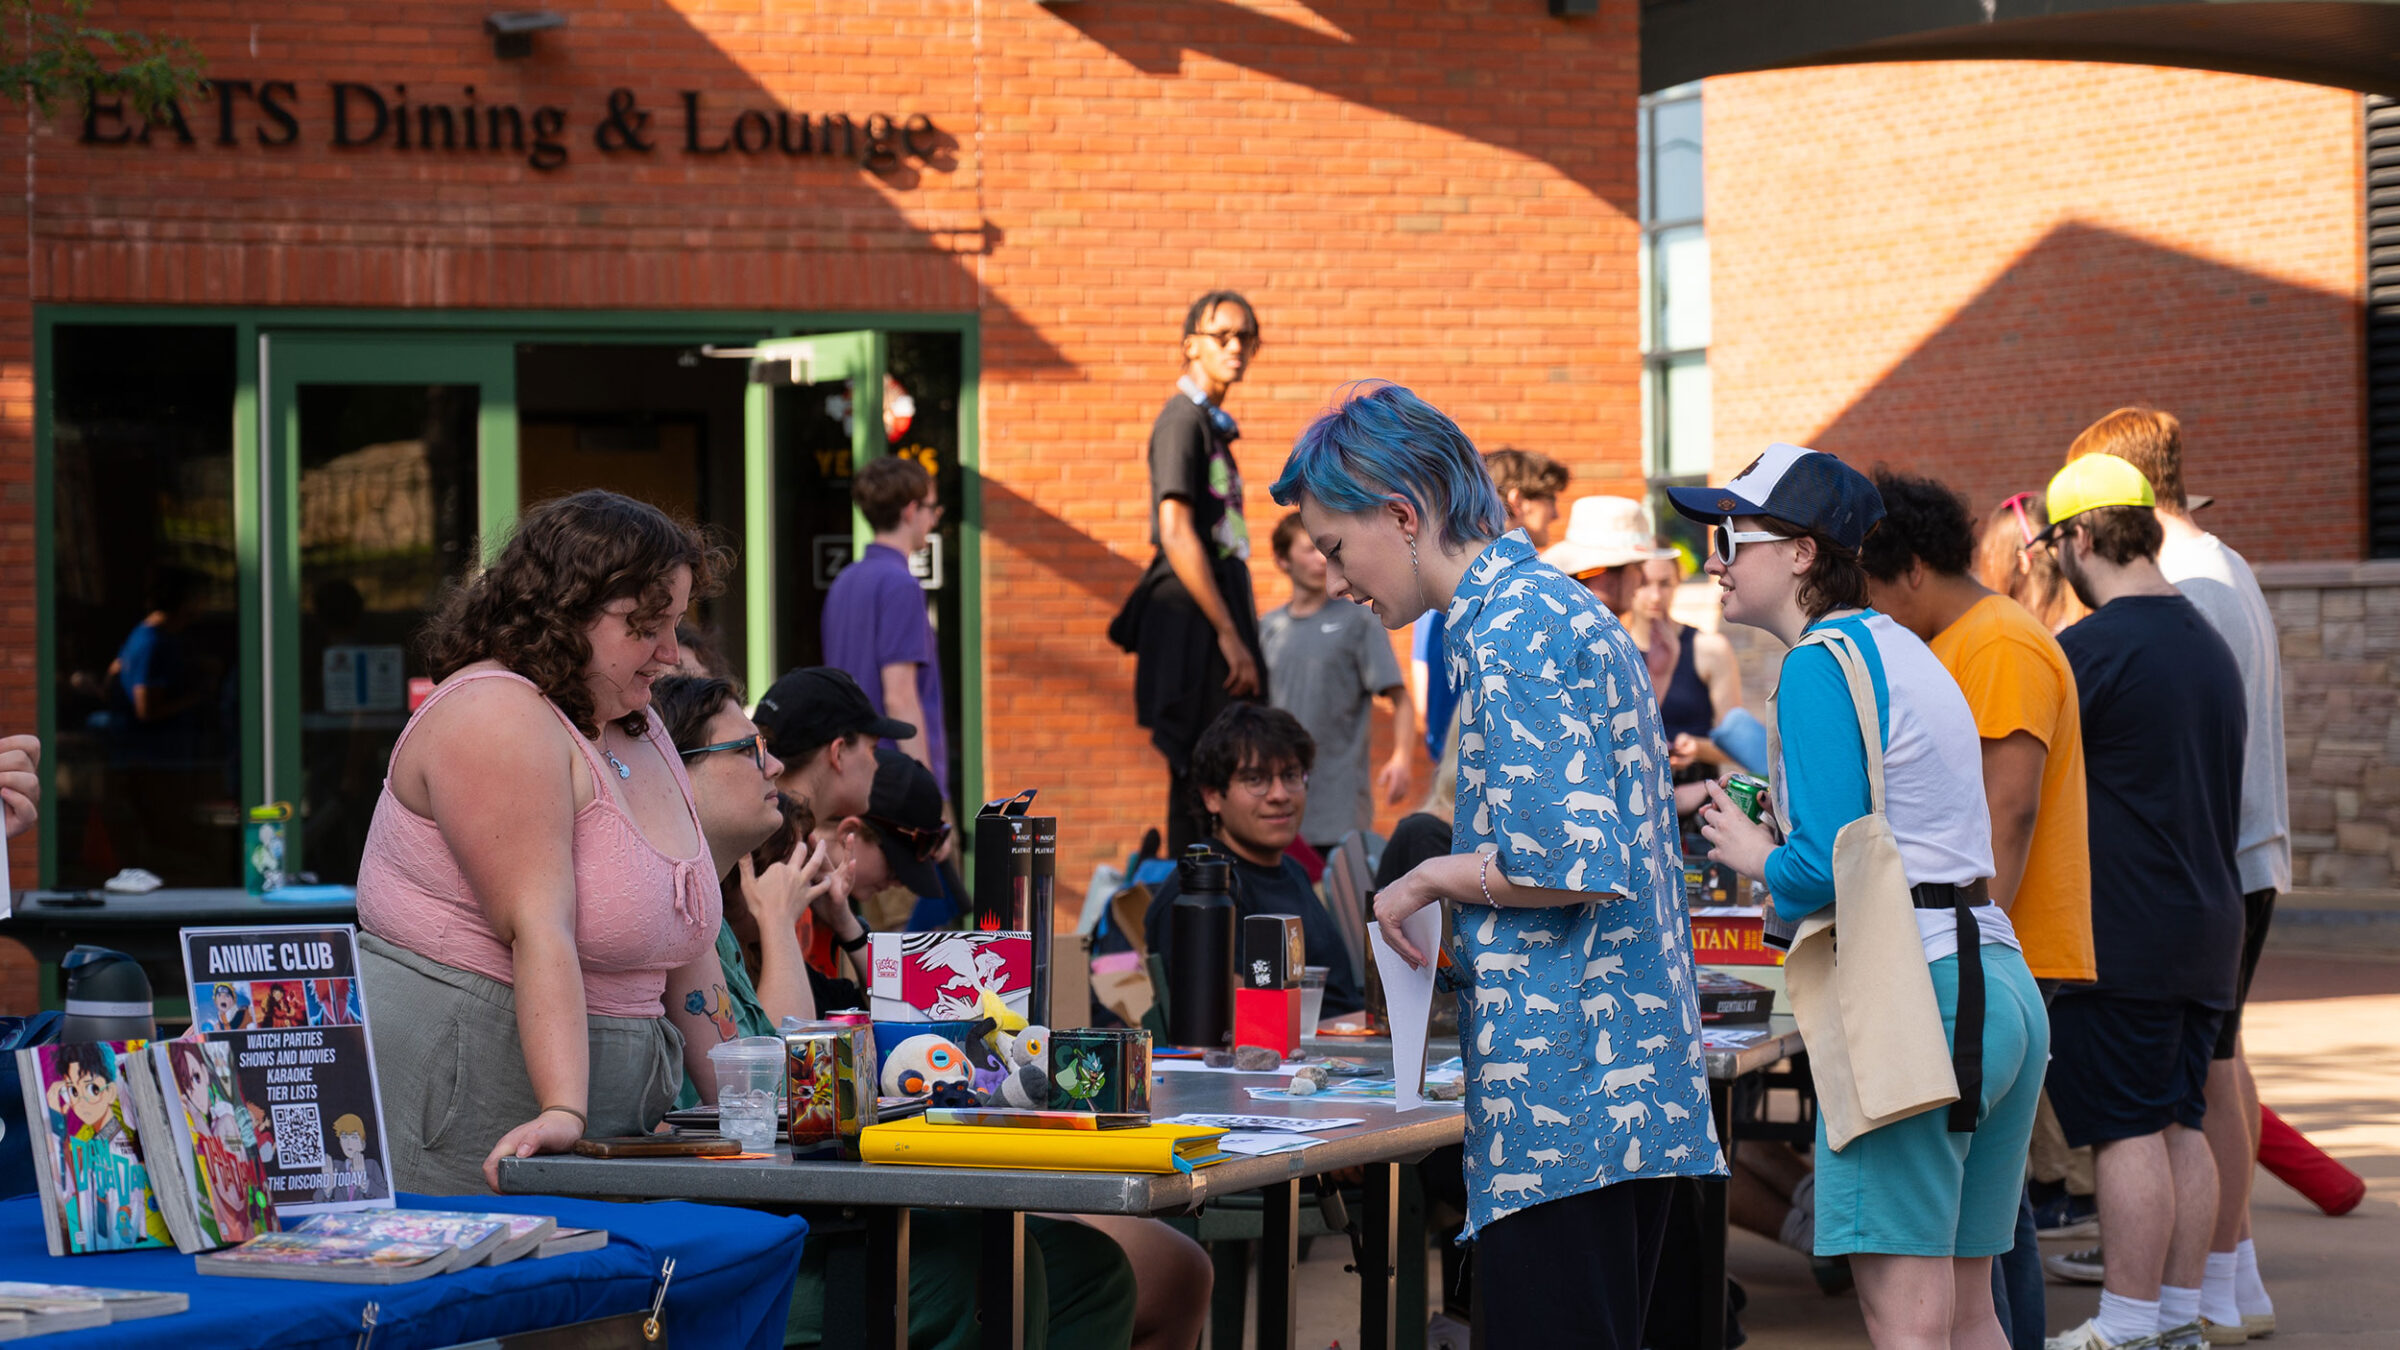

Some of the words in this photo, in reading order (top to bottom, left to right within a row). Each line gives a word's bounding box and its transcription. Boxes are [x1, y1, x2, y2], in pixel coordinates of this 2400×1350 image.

[80, 79, 299, 146] EATS
[331, 83, 568, 170] Dining
[595, 88, 653, 153] &
[682, 90, 935, 170] Lounge
[208, 945, 277, 974] ANIME
[279, 942, 334, 971] CLUB
[1746, 999, 1758, 1012] KIT
[247, 1034, 281, 1049] WATCH
[282, 1031, 323, 1047] PARTIES
[239, 1051, 275, 1067] SHOWS
[276, 1051, 299, 1065] AND
[300, 1049, 336, 1064] MOVIES
[266, 1067, 313, 1083] KARAOKE
[266, 1086, 289, 1101] TIER
[290, 1084, 318, 1100] LISTS
[267, 1176, 286, 1191] THE
[288, 1173, 330, 1190] DISCORD
[332, 1171, 367, 1187] TODAY!
